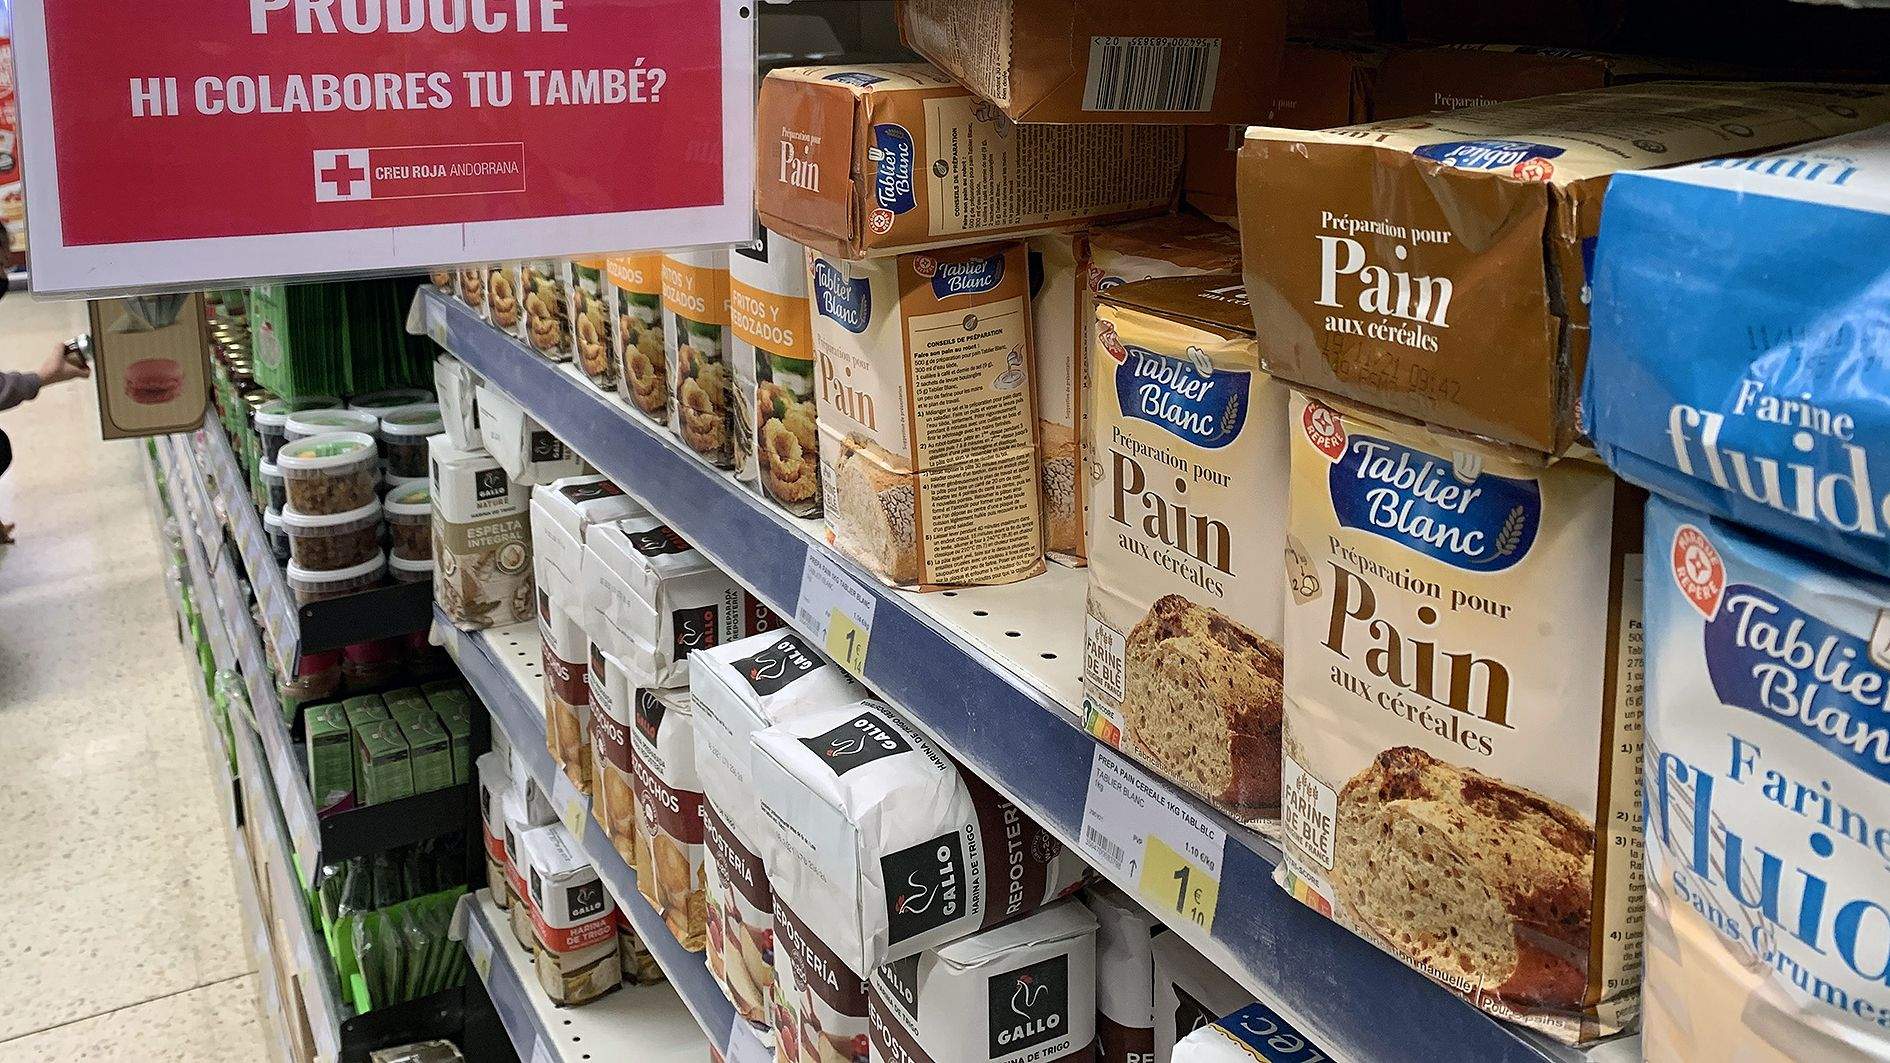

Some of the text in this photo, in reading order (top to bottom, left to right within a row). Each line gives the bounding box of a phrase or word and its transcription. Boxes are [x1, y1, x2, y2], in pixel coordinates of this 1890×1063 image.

[250, 0, 568, 34] PRODUCTE
[130, 57, 667, 117] HI COLABORES TU TAMBÉ?
[375, 161, 519, 182] CREU ROJA ANDORRANA
[779, 140, 820, 193] Pain
[877, 147, 896, 207] Tablier
[895, 142, 910, 196] Blanc
[1321, 211, 1452, 246] Préparation pour
[686, 274, 696, 290] Y
[815, 261, 852, 303] Tablier
[938, 257, 988, 279] Tablier
[948, 273, 993, 293] Blanc
[1314, 235, 1454, 328] Pain
[732, 289, 780, 323] FRITOS Y
[822, 290, 859, 326] Blanc
[1325, 314, 1439, 352] aux céréales
[817, 350, 879, 433] Pain
[1130, 349, 1215, 404] Tablier
[1138, 384, 1215, 437] Blanc
[1732, 379, 1856, 441] Farine
[1112, 425, 1232, 489] Préparation pour
[1353, 439, 1483, 515] Tablier
[1666, 404, 1890, 539] fluid
[467, 519, 523, 540] ESPELTA
[1108, 446, 1236, 578] Pain
[1366, 487, 1485, 557] Blanc
[467, 531, 524, 549] INTEGRAL
[1118, 531, 1225, 600] aux céréales
[1328, 535, 1513, 622] Préparation pour
[704, 610, 714, 649] ALLO
[846, 628, 856, 664] 1
[1320, 560, 1516, 731] Pain
[777, 641, 814, 671] GALLO
[1086, 636, 1122, 674] FARINE
[1086, 654, 1122, 690] DE BLÉ
[1330, 663, 1495, 758] aux céréales
[1752, 663, 1890, 766] Blan
[853, 718, 898, 750] GALLO
[910, 732, 923, 744] DE
[920, 742, 947, 771] HARINA
[1095, 767, 1145, 809] TABLIER BLANC
[1097, 753, 1119, 775] PREPA
[1119, 767, 1135, 786] PAIN
[1135, 777, 1166, 807] CEREALE
[1166, 801, 1180, 817] 1KG
[1285, 784, 1331, 835] FARINE
[1285, 804, 1328, 855] DE BLÉ
[965, 823, 982, 915] HARINA DE TRIGO
[997, 800, 1022, 917] REPOSTERÍ
[1304, 842, 1330, 866] FRANCE
[942, 844, 956, 917] GALLO
[1173, 865, 1205, 927] 1 € 10
[572, 901, 602, 917] GALLO
[1673, 869, 1741, 940] Sans
[566, 926, 612, 946] DE TRIGO
[569, 919, 606, 936] HARINA
[1416, 961, 1473, 995] manuelle
[1483, 996, 1512, 1018] Pour
[997, 1014, 1061, 1046] GALLO
[1027, 1040, 1071, 1063] DE TRIGO
